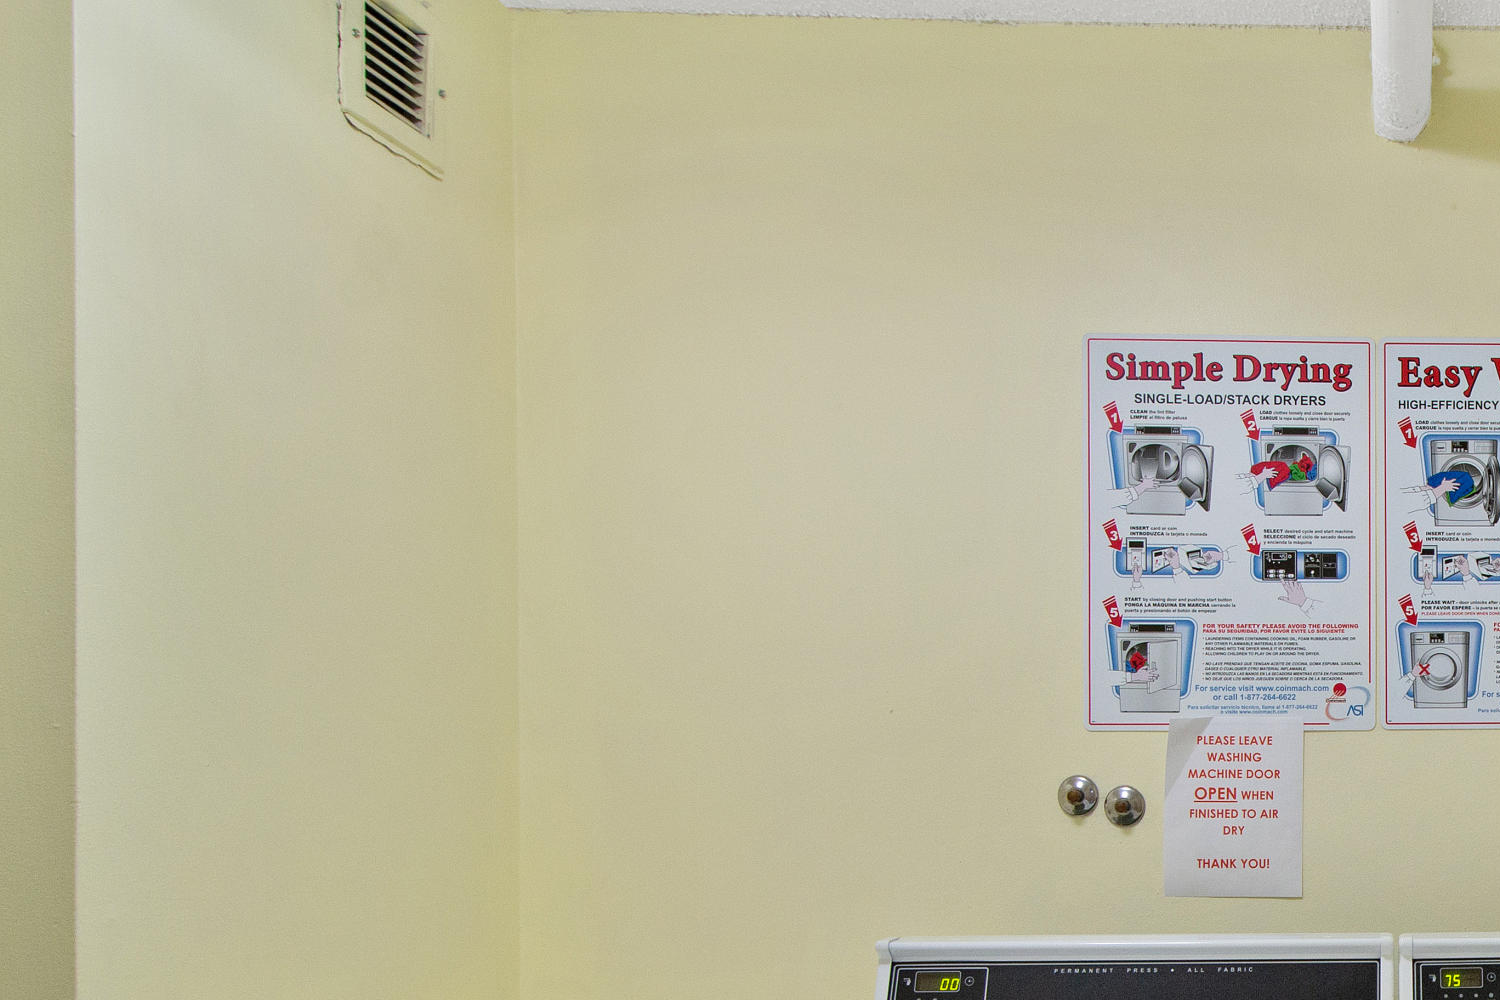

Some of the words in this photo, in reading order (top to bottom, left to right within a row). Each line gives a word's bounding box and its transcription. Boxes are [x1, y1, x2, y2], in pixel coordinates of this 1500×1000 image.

[1106, 352, 1224, 390] Simple
[1232, 354, 1352, 392] Drying
[1398, 356, 1482, 398] Easy
[1134, 394, 1270, 405] SINGLE-LOAD/STACK
[1274, 395, 1326, 406] DRYERS
[1398, 400, 1499, 410] HIGH-EFFICIENCY
[1111, 413, 1118, 423] 1
[1248, 421, 1256, 431] 2
[1405, 428, 1412, 438] 1
[1110, 531, 1118, 541] 3
[1248, 536, 1256, 546] 4
[1410, 532, 1419, 542] 3
[1110, 608, 1118, 618] 5
[1405, 606, 1414, 616] 5
[1196, 736, 1235, 745] PLEASE
[1239, 736, 1273, 745] LEAVE
[1207, 752, 1262, 762] WASHING
[1188, 770, 1243, 779] MACHINE
[1246, 770, 1280, 779] DOOR
[1194, 787, 1237, 801] OPEN
[1241, 791, 1274, 800] WHEN
[1189, 809, 1238, 818] FINISHED
[1242, 809, 1256, 818] TO
[1260, 809, 1279, 818] AIR
[1223, 826, 1244, 835] DRY
[1197, 859, 1236, 868] THANK
[1241, 859, 1270, 868] YOU!
[940, 978, 960, 991] 00
[1445, 974, 1461, 986] 75
